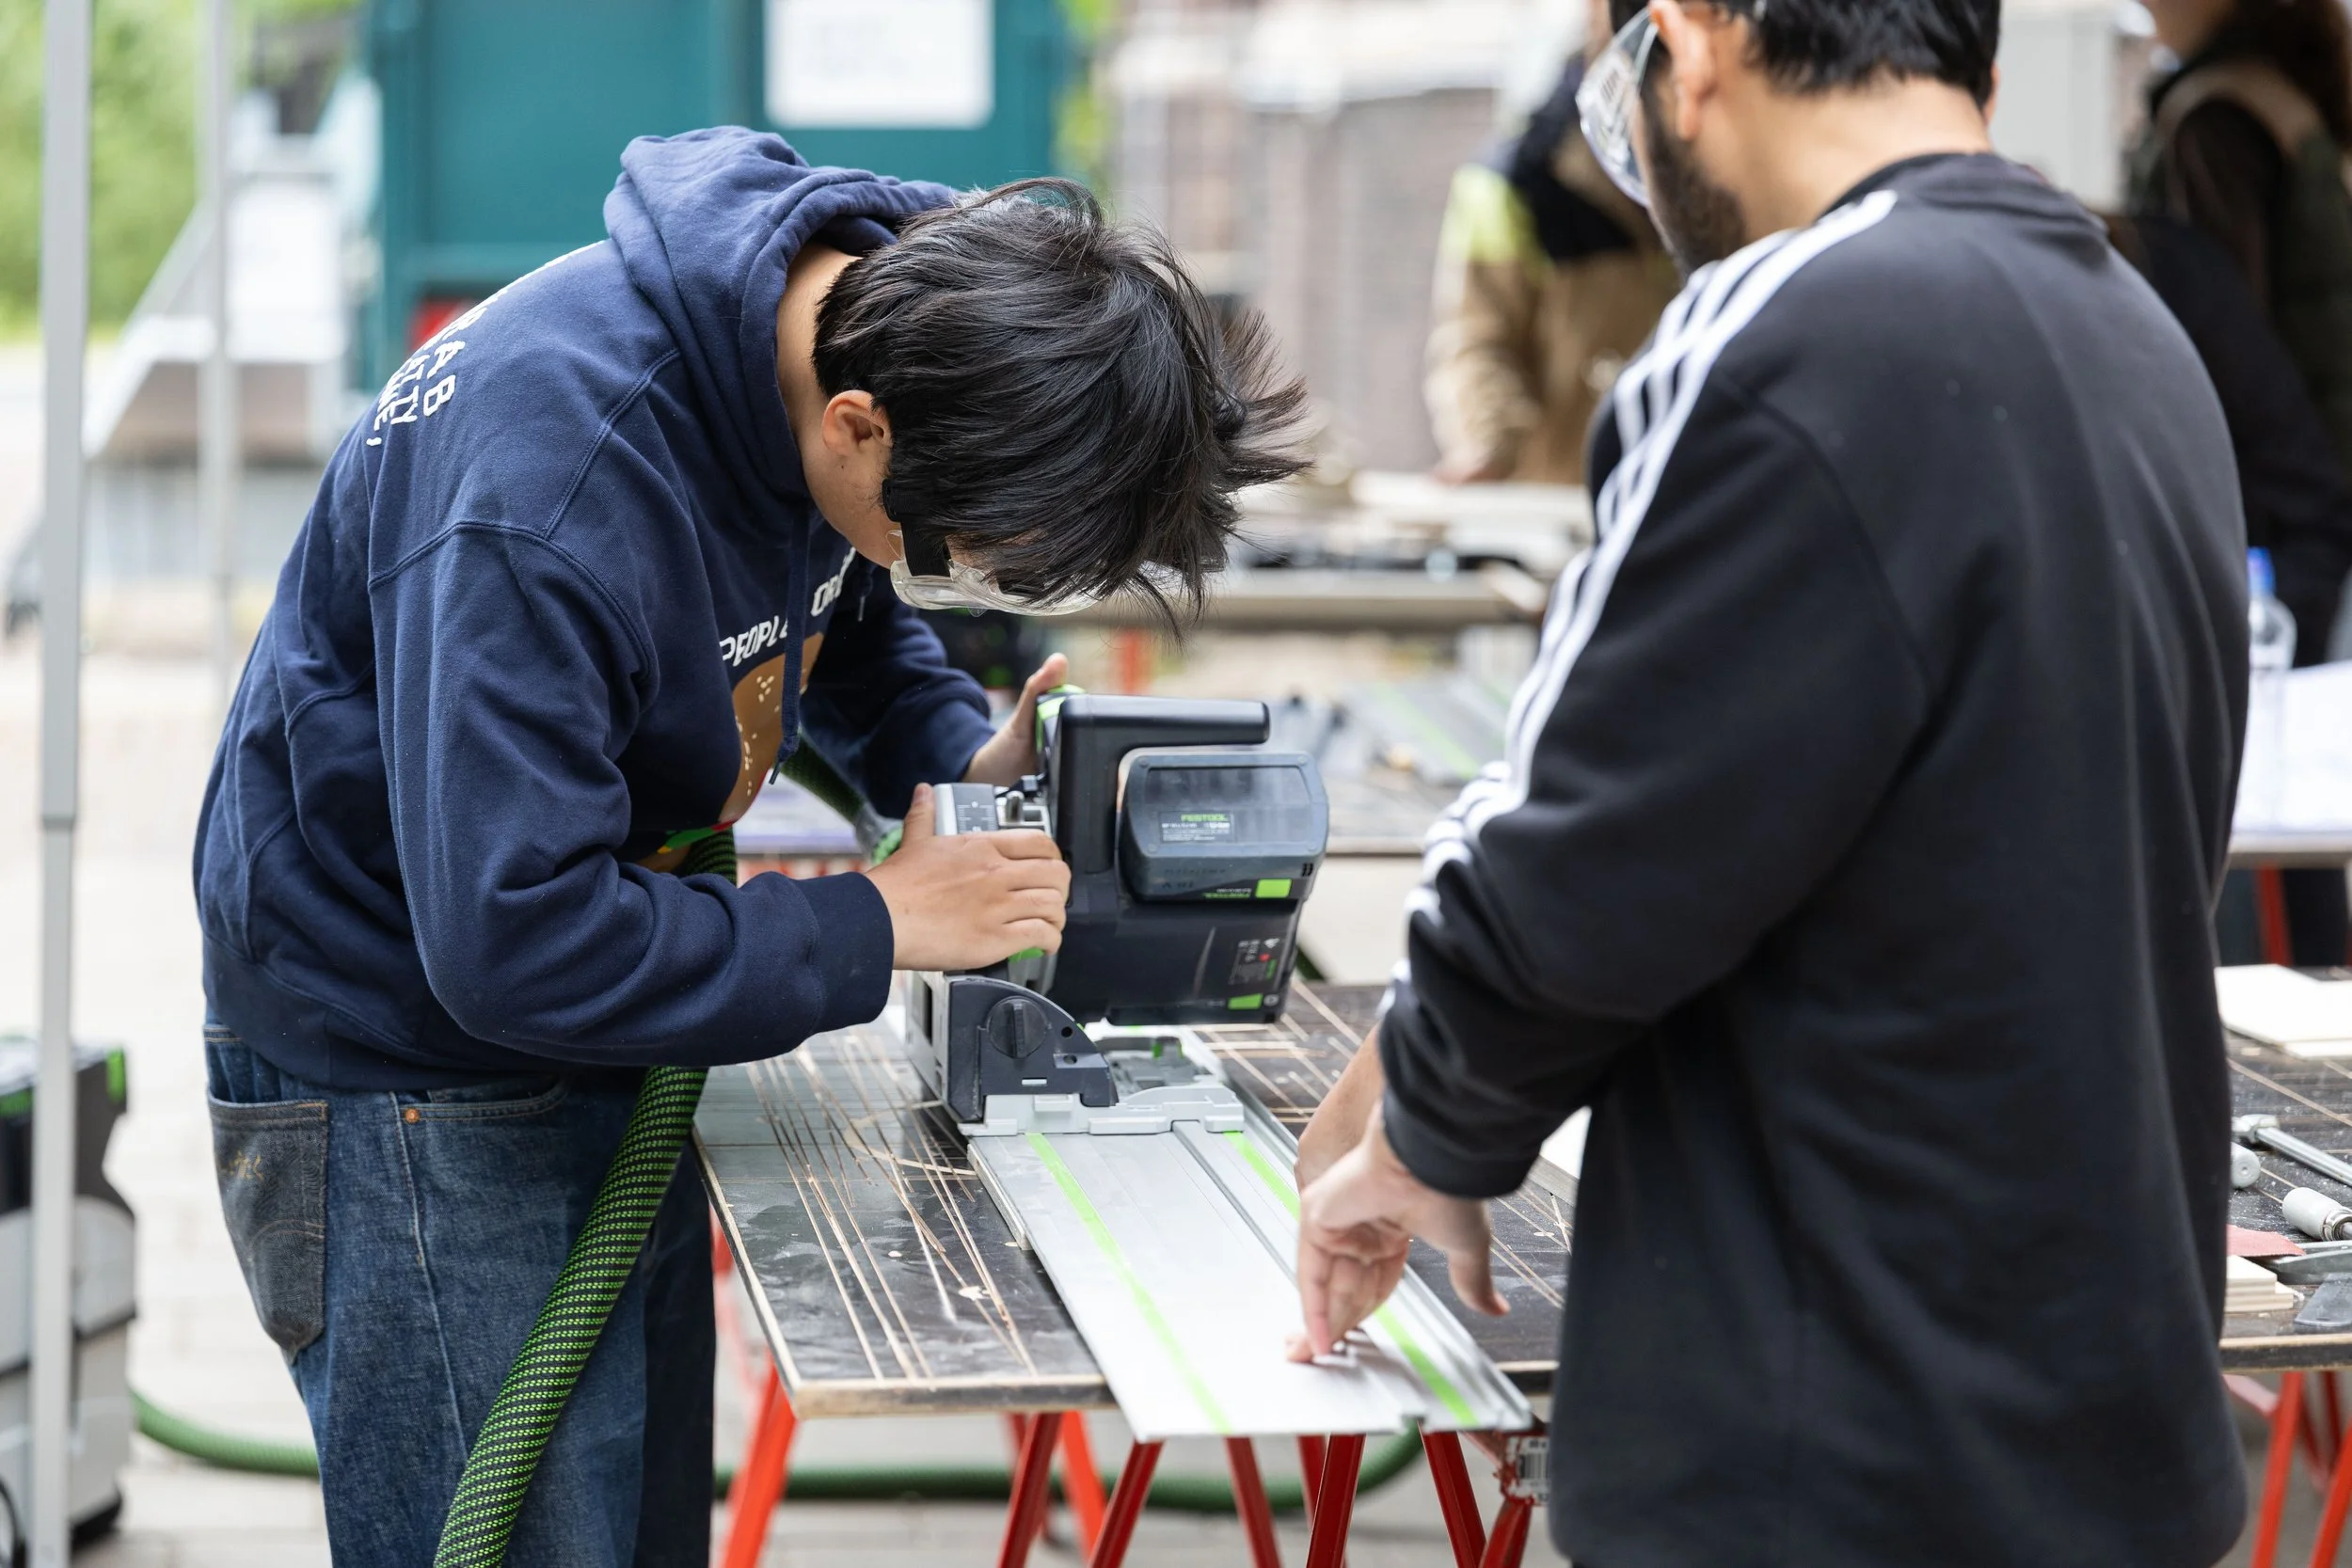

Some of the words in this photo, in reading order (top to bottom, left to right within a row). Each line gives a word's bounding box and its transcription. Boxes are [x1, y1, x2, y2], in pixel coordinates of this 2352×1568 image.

[389, 350, 435, 425] ATTY
[422, 292, 503, 416] RAB
[1180, 814, 1229, 822] FESTOOL
